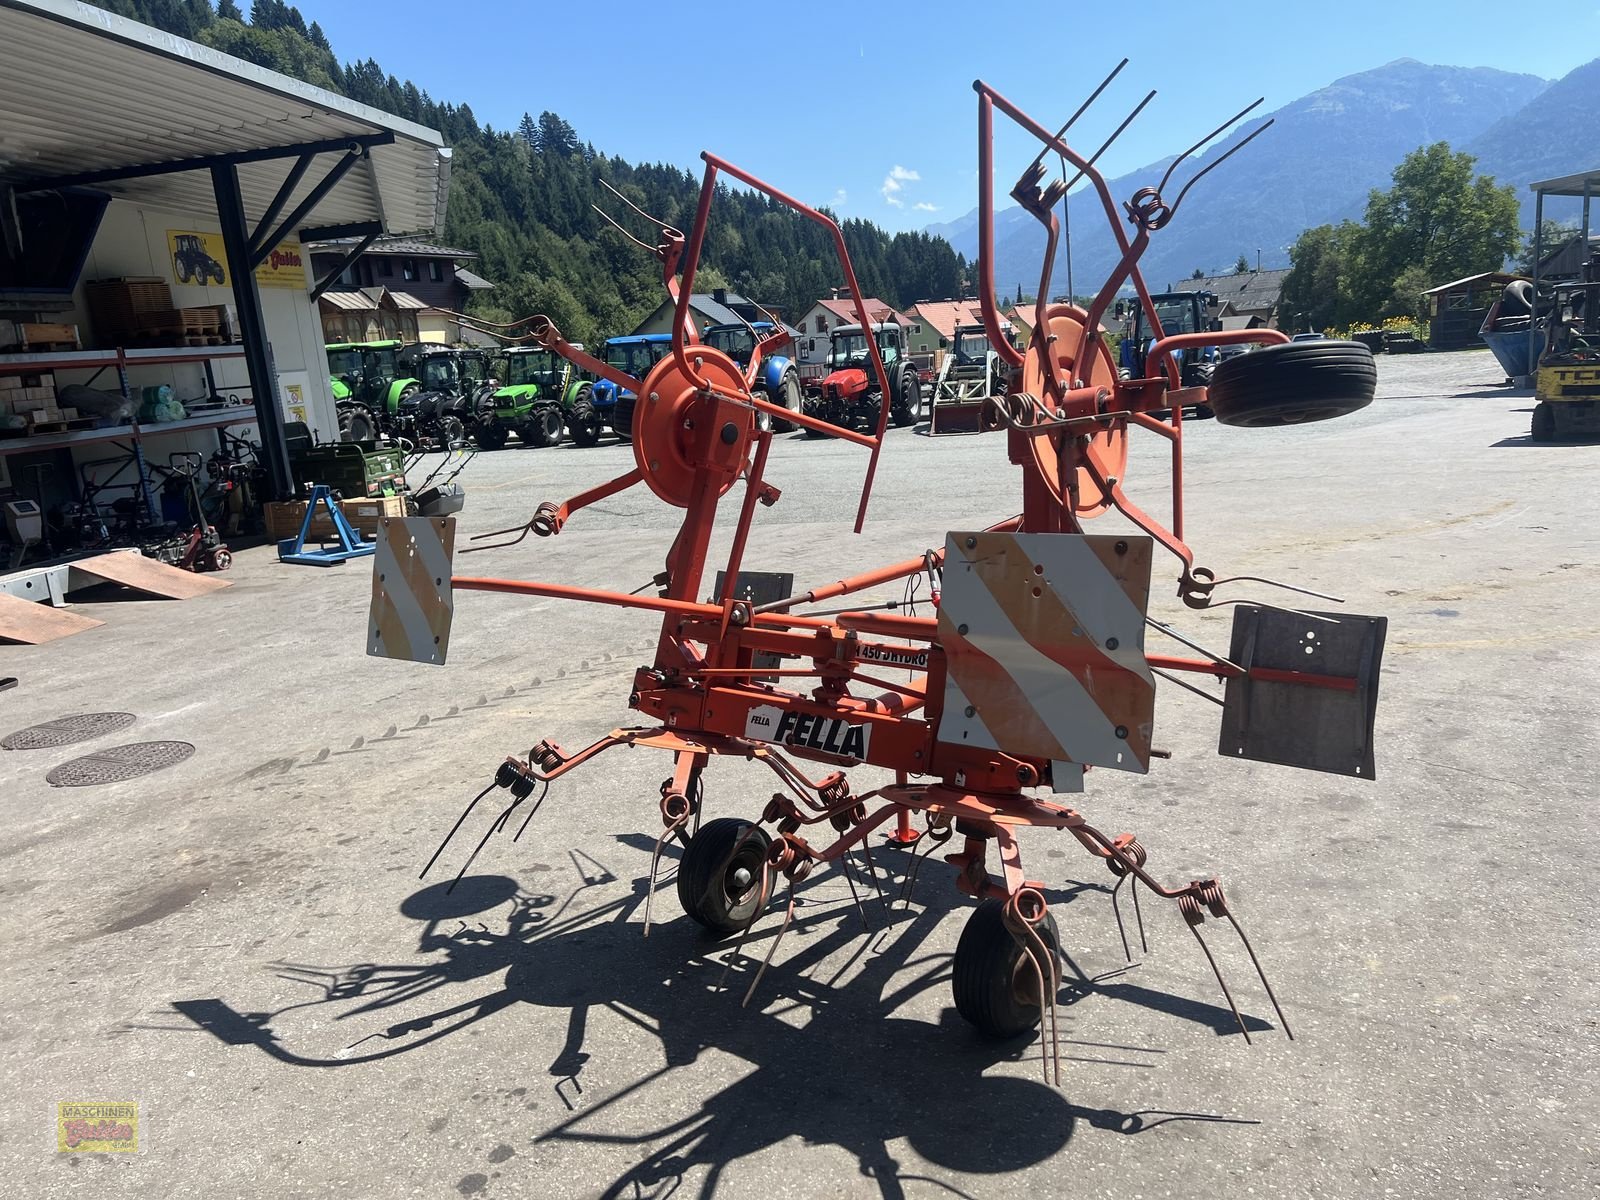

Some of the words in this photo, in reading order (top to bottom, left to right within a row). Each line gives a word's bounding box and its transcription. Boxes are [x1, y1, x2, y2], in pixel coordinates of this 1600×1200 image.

[1554, 370, 1600, 381] TC
[862, 645, 880, 659] 450
[750, 715, 770, 727] FELLA
[774, 709, 865, 759] FELLA
